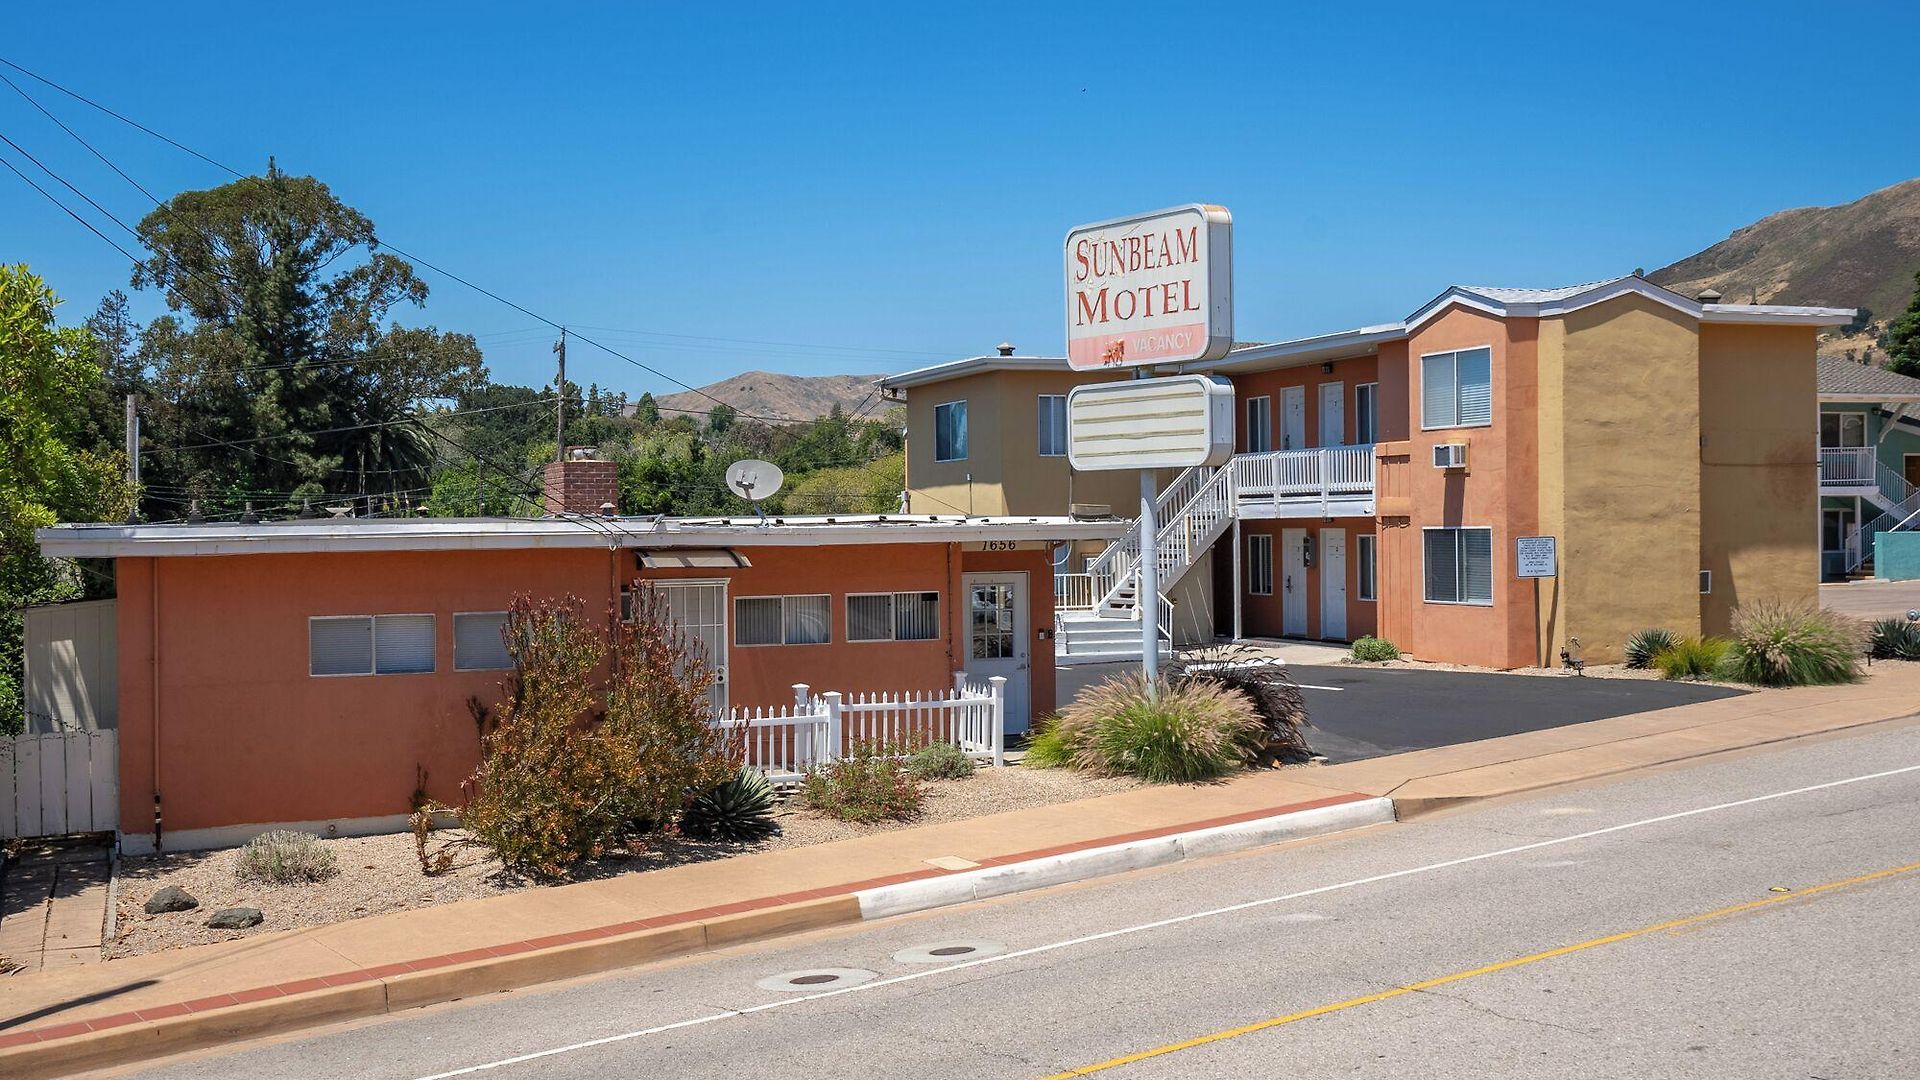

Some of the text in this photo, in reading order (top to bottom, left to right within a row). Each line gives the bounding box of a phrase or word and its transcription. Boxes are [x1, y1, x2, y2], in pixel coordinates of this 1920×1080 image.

[1076, 226, 1198, 281] SUNBEAM
[1076, 280, 1200, 326] MOTEL
[1133, 332, 1192, 353] VACANCY
[983, 540, 1016, 551] 1656
